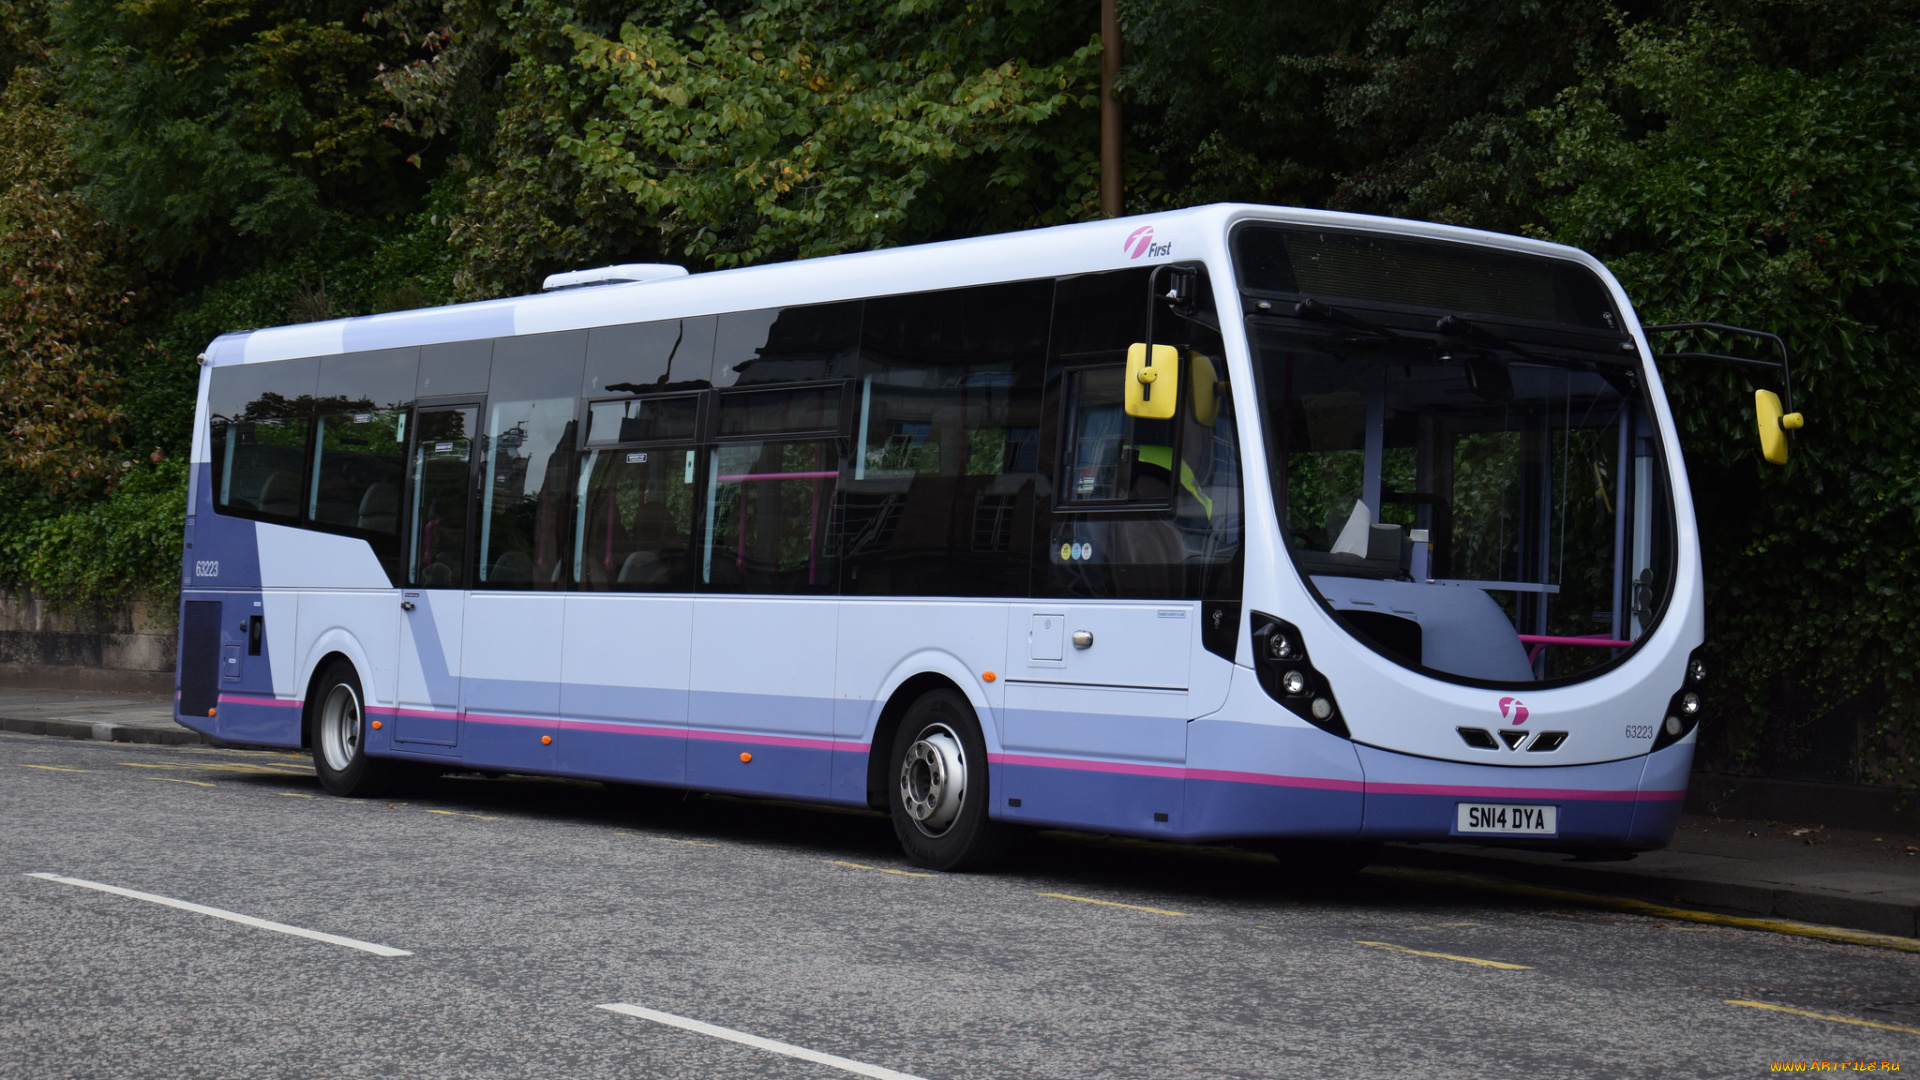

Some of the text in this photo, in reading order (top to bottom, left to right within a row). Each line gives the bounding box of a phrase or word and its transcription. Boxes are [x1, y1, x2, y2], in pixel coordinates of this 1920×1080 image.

[1148, 241, 1172, 258] First
[195, 560, 219, 577] 63223
[1625, 725, 1653, 739] 63223
[1469, 806, 1545, 830] SN14 DYA
